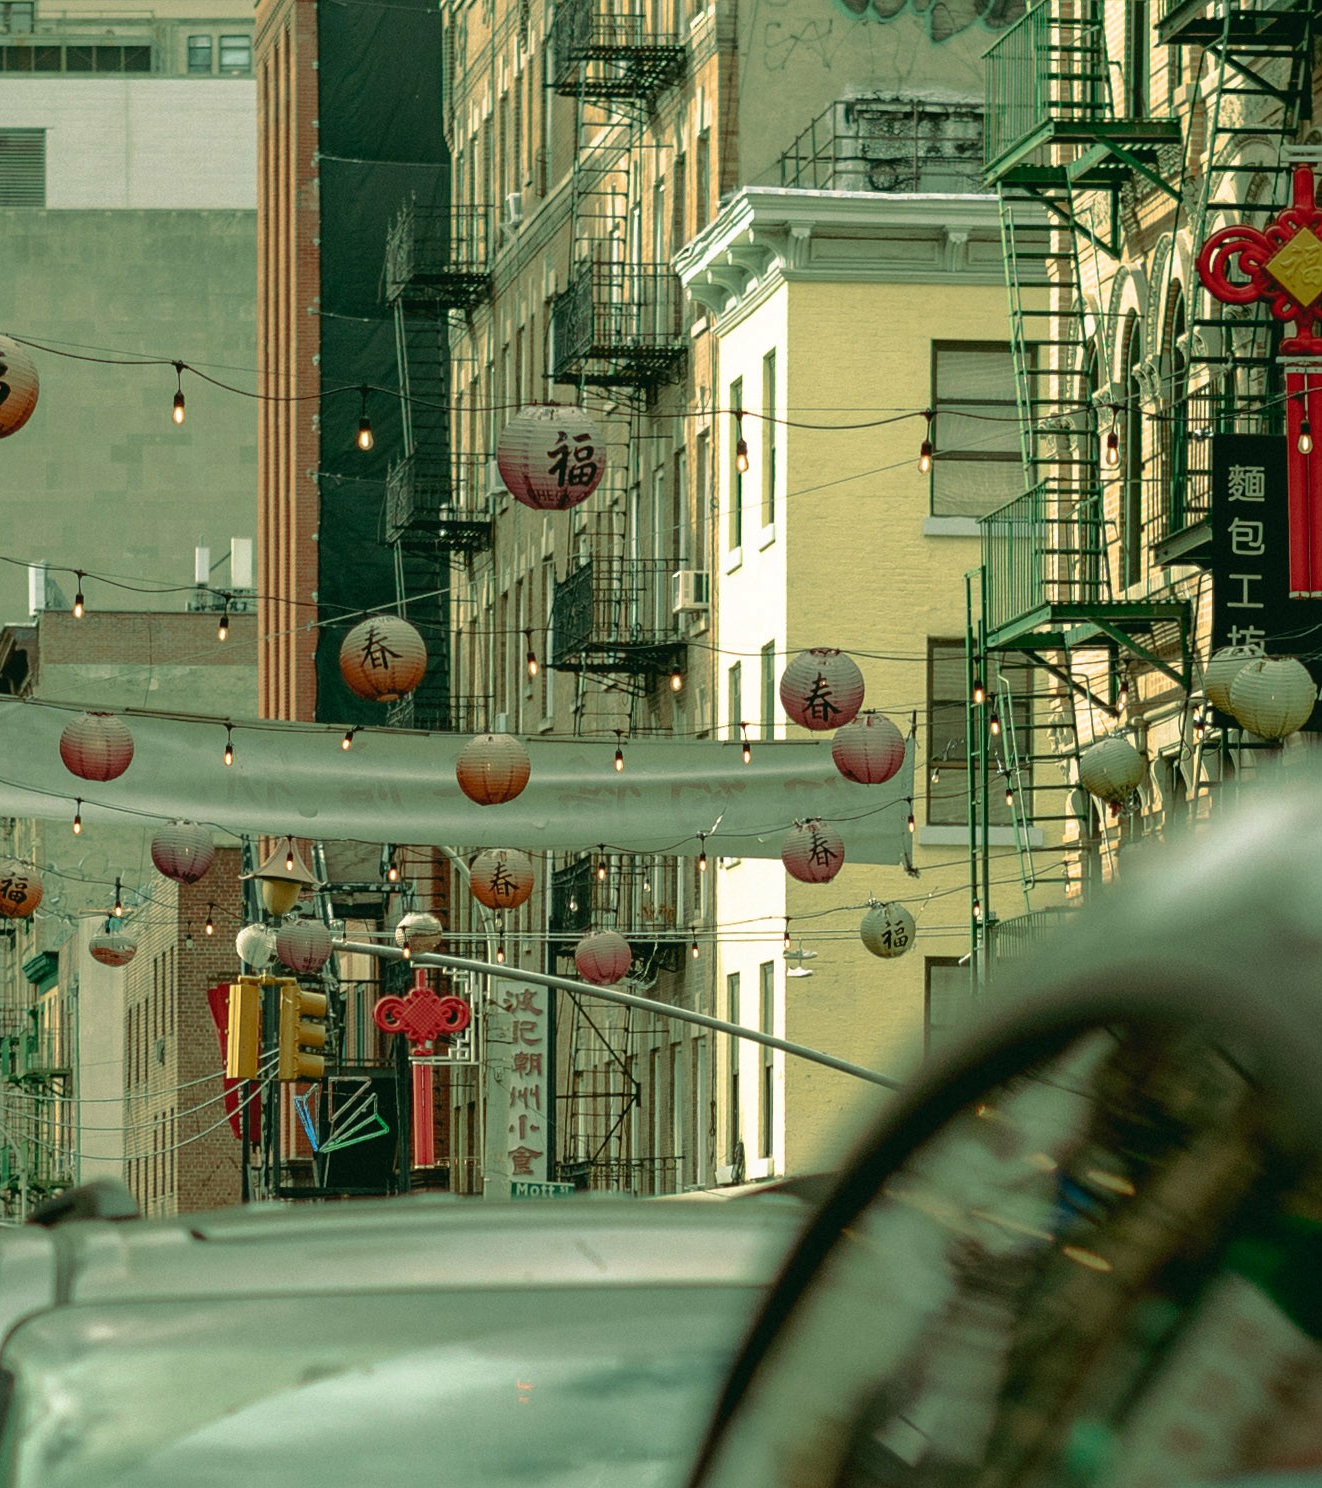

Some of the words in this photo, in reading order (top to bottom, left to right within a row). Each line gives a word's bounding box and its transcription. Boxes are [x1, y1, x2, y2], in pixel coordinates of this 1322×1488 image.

[547, 431, 598, 488] 福
[361, 625, 403, 670] 春
[802, 672, 843, 722] 春
[808, 832, 838, 867] 春
[0, 872, 28, 903] 福
[489, 861, 520, 897] 春
[882, 920, 909, 949] 福
[515, 1183, 555, 1200] Mott
